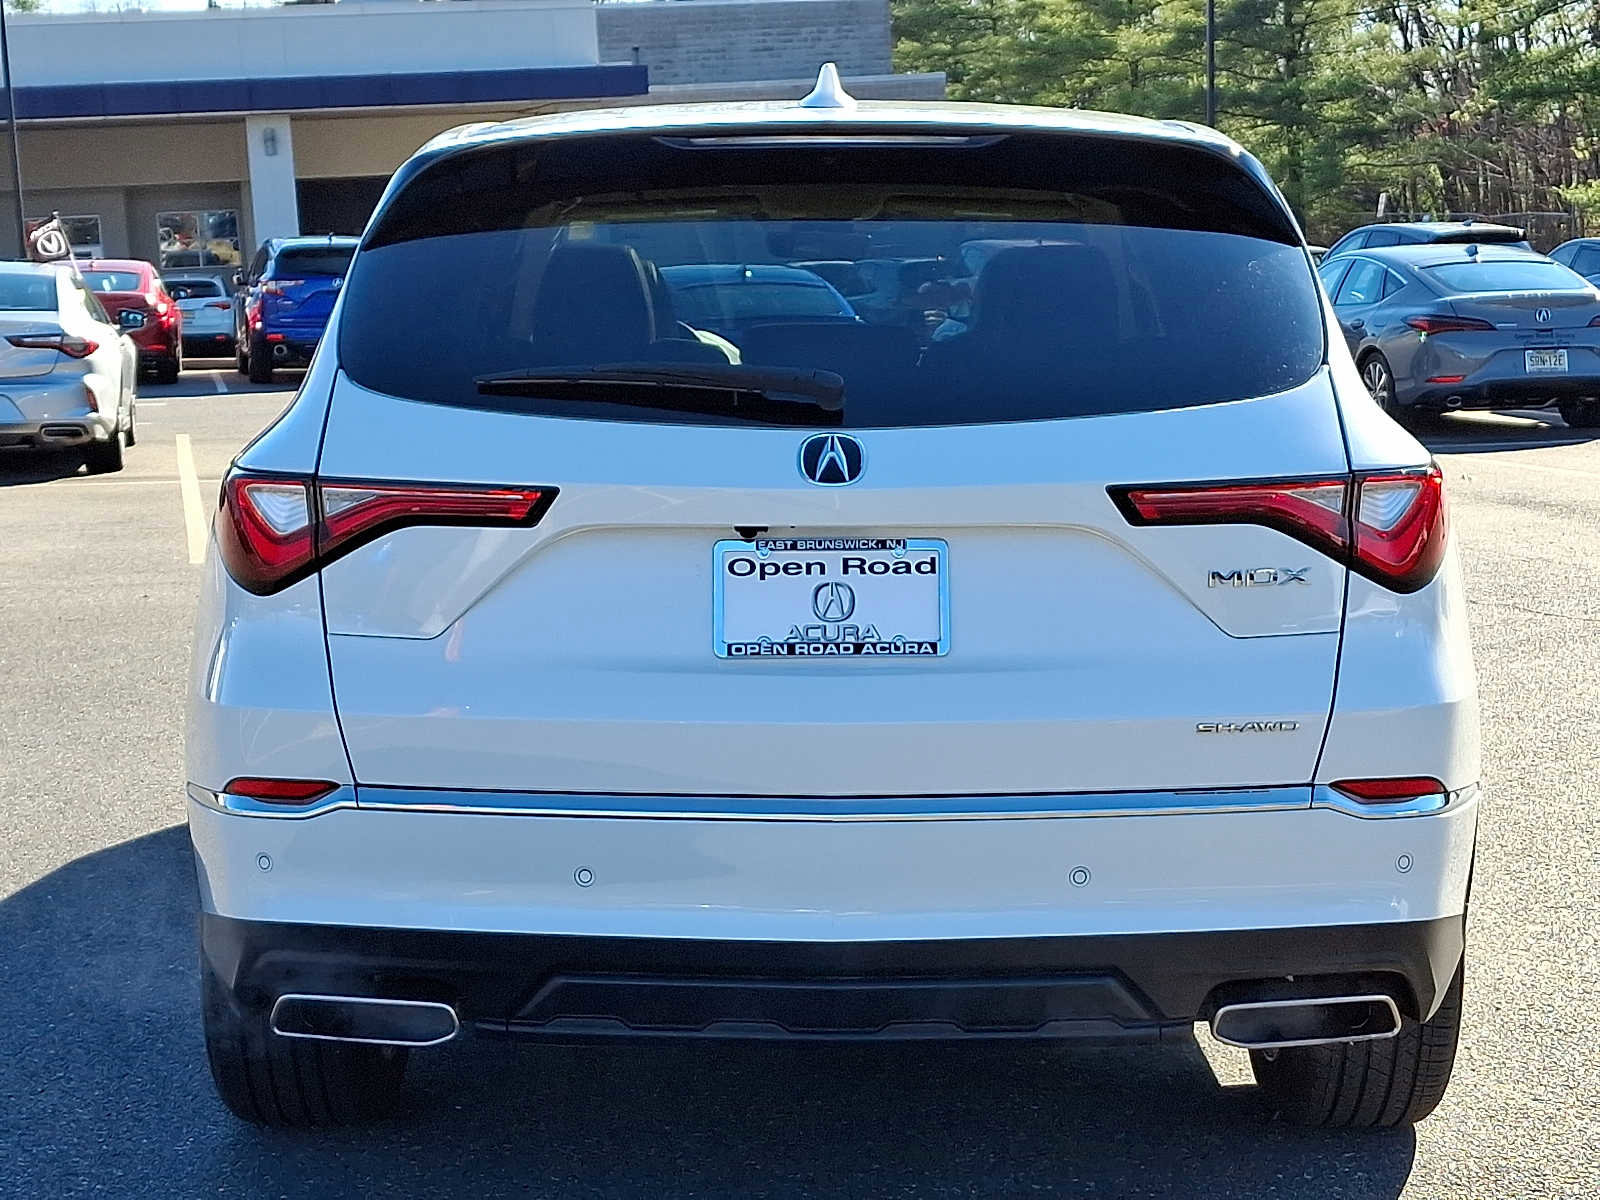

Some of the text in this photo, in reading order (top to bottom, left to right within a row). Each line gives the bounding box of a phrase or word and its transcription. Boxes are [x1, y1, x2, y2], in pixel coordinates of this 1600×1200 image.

[758, 539, 904, 550] EAST BRUNSWICK, NJ
[728, 556, 937, 580] Open Road
[1207, 567, 1312, 588] MDX
[785, 624, 882, 642] ACURA
[731, 643, 934, 655] OPEN ROAD ACURA
[1196, 721, 1300, 733] SH-AWD
